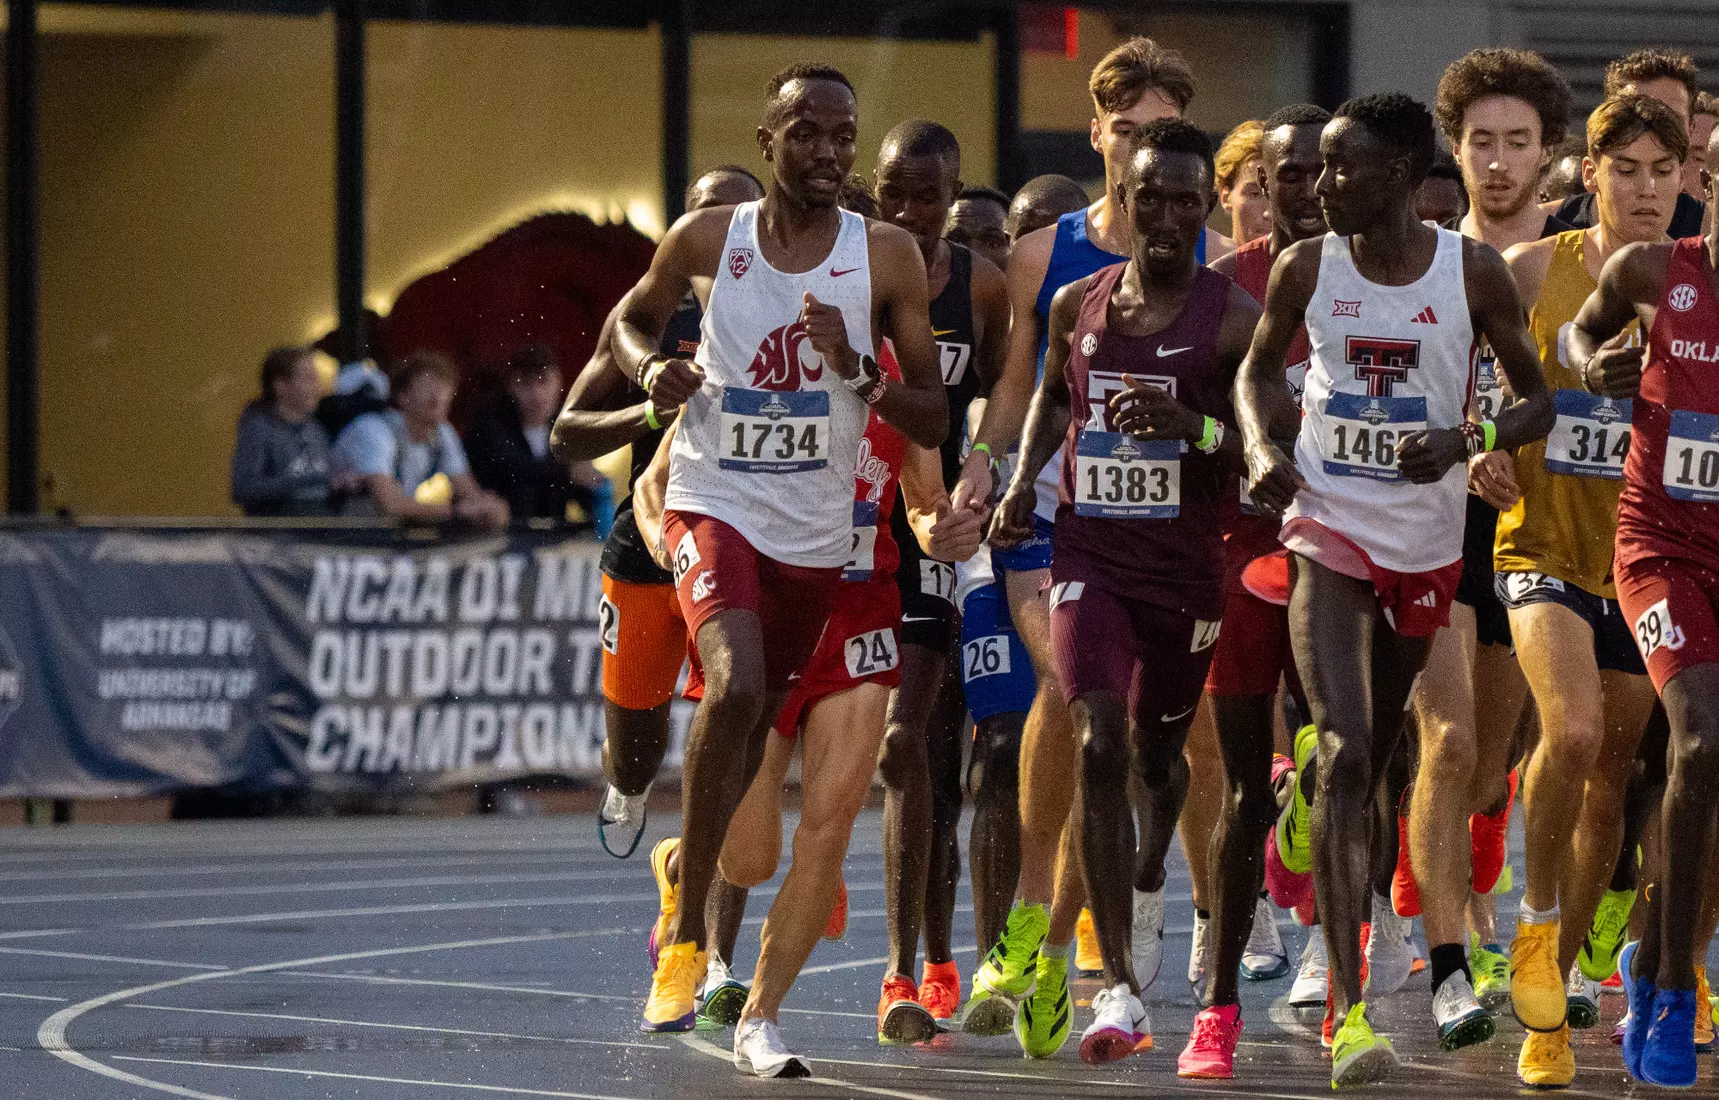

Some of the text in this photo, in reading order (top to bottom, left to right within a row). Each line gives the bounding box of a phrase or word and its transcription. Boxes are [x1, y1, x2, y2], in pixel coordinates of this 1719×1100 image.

[730, 249, 753, 266] PAC
[732, 261, 746, 274] 12
[1671, 286, 1696, 310] SEC
[731, 421, 819, 459] 1734
[1569, 424, 1632, 464] 314
[1087, 464, 1170, 502] 1383
[307, 553, 451, 623] NCAA
[459, 553, 528, 622] DI
[100, 617, 206, 656] HOSTED
[851, 632, 893, 674] 24
[1638, 611, 1662, 659] 39
[309, 629, 555, 698] OUTDOOR
[968, 638, 1000, 678] 26
